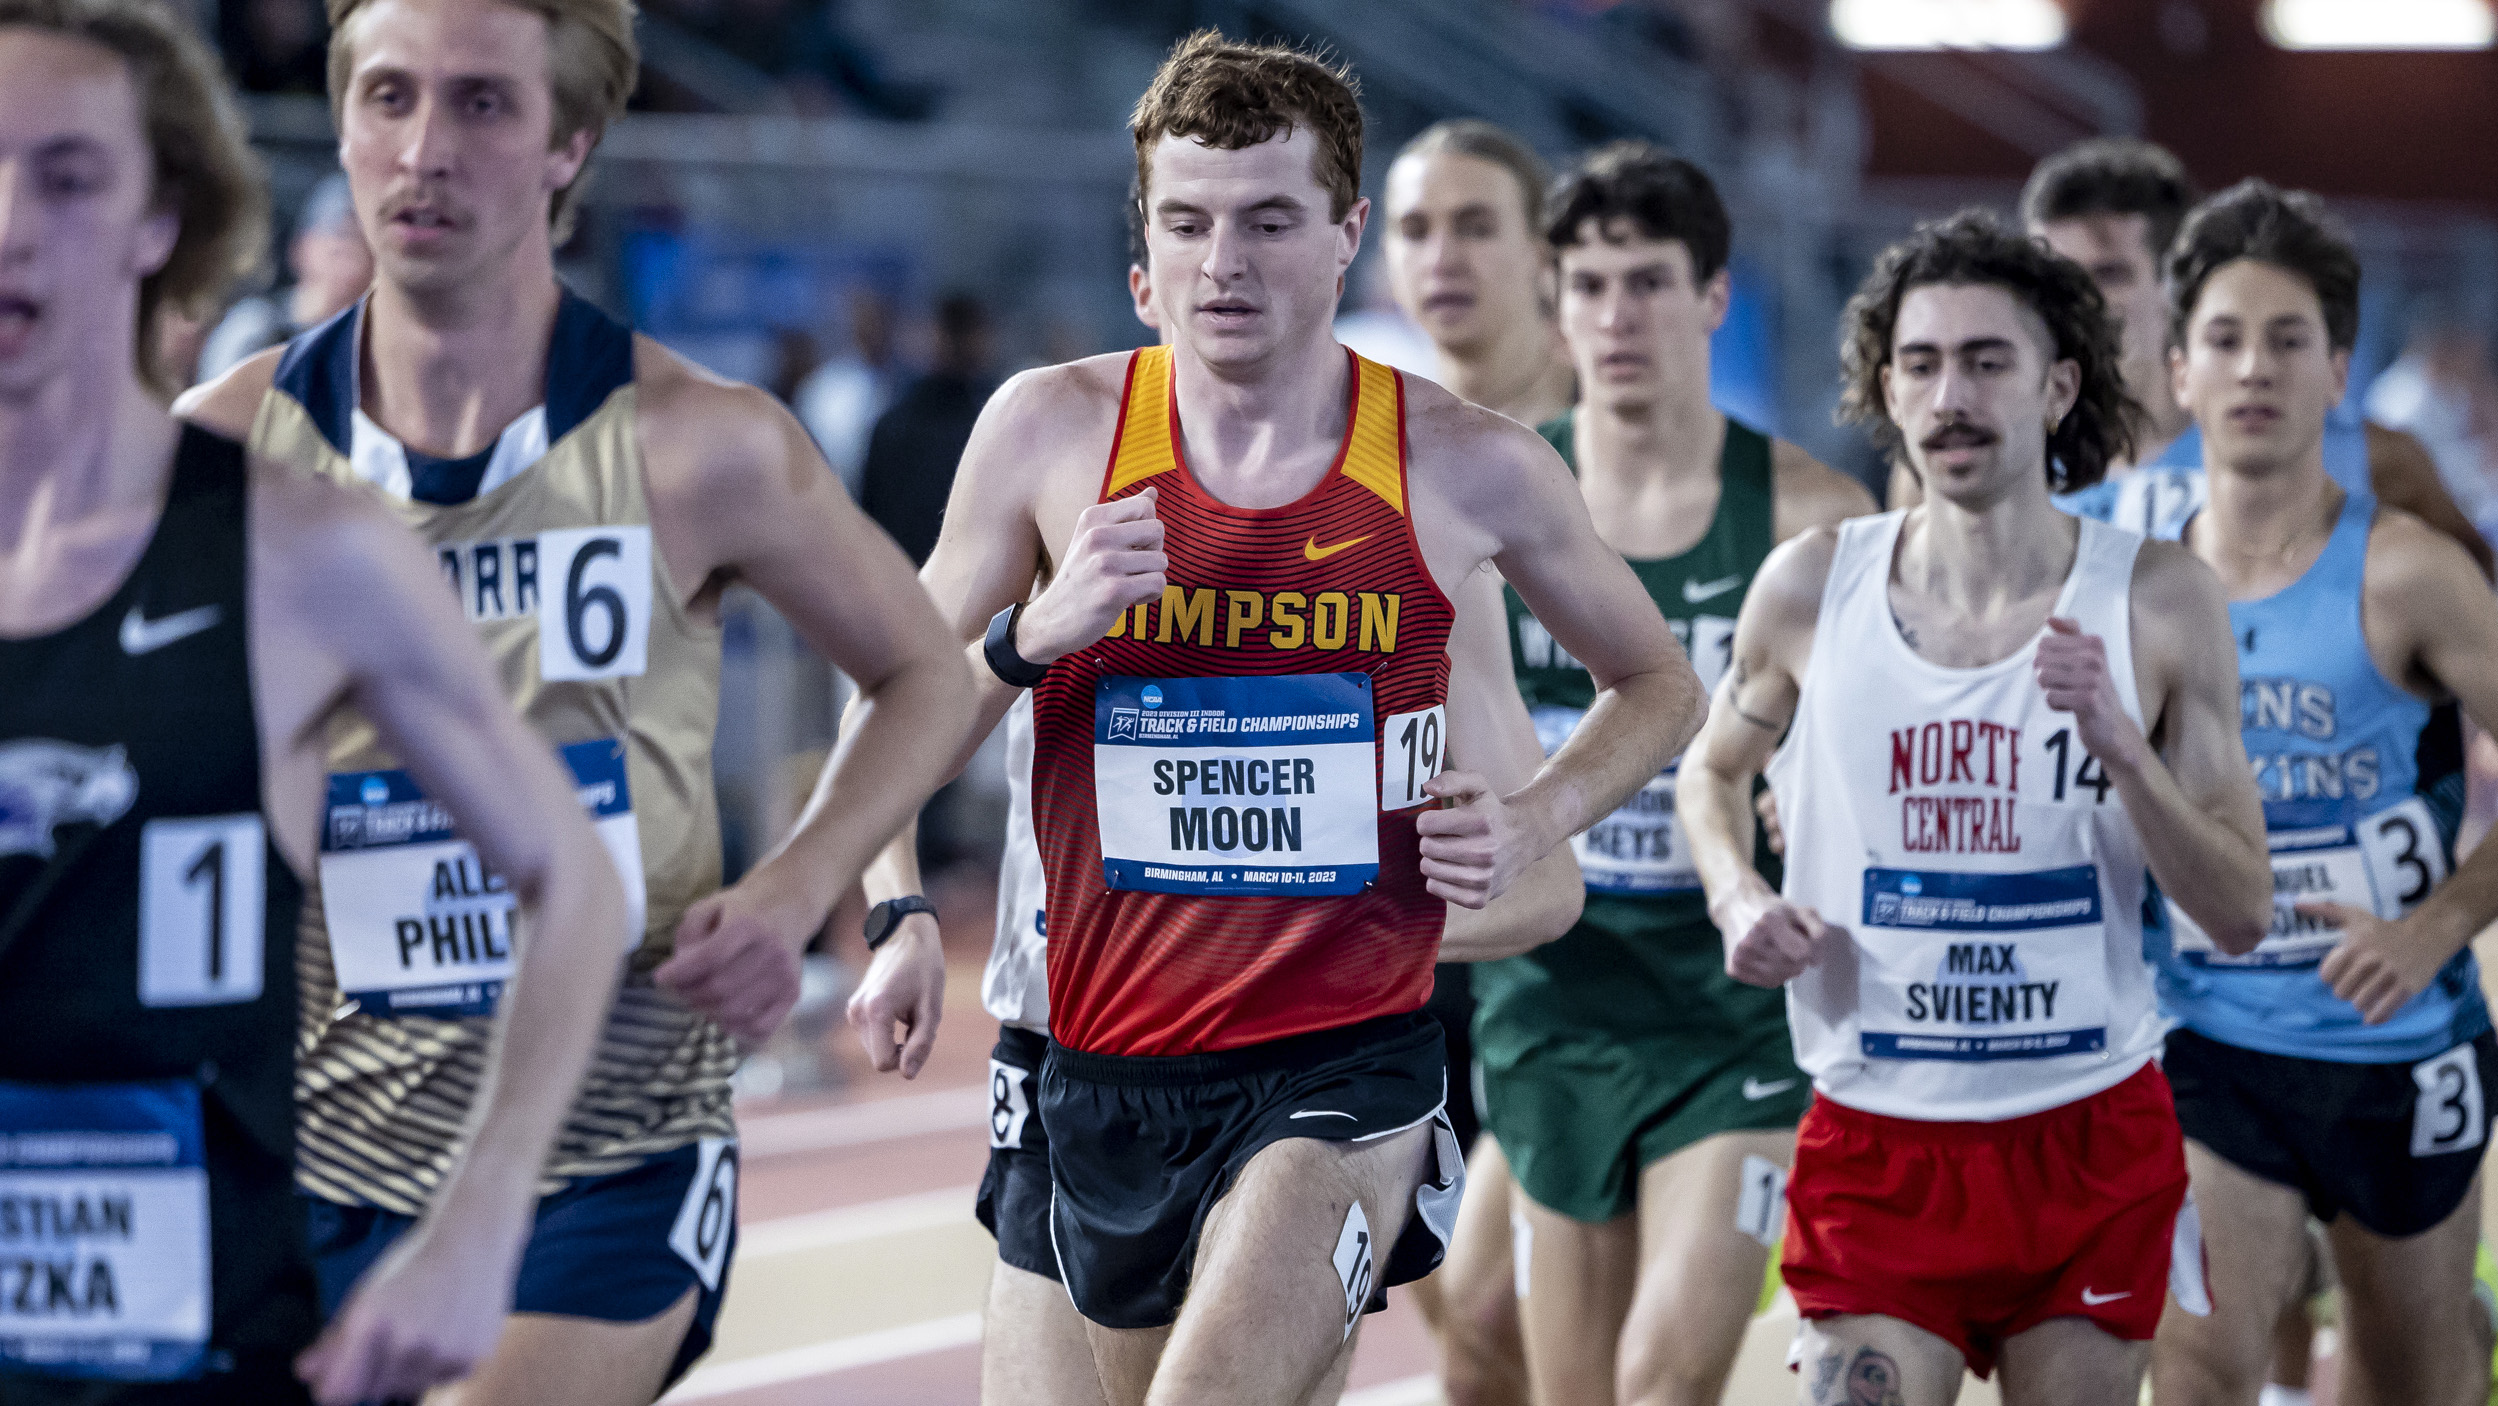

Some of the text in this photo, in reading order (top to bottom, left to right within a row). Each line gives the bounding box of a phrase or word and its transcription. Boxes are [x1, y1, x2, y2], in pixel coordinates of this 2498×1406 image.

[566, 537, 628, 668] 6
[1140, 713, 1360, 733] TRACK & FIELD CHAMPIONSHIPS
[1400, 711, 1438, 801] 19
[1153, 758, 1316, 796] SPENCER
[2044, 727, 2112, 804] 14
[1169, 806, 1302, 852] MOON
[1903, 796, 2021, 853] CENTRAL
[2380, 816, 2431, 906] 3
[187, 841, 224, 983] 1
[1144, 867, 1336, 884] BIRMINGHAM, AL MARCH 10-11, 2023
[1949, 943, 2016, 975] MAX
[1906, 980, 2059, 1023] SVIENTY
[993, 1068, 1013, 1142] 8
[2433, 1062, 2467, 1144] 3
[697, 1145, 739, 1260] 6
